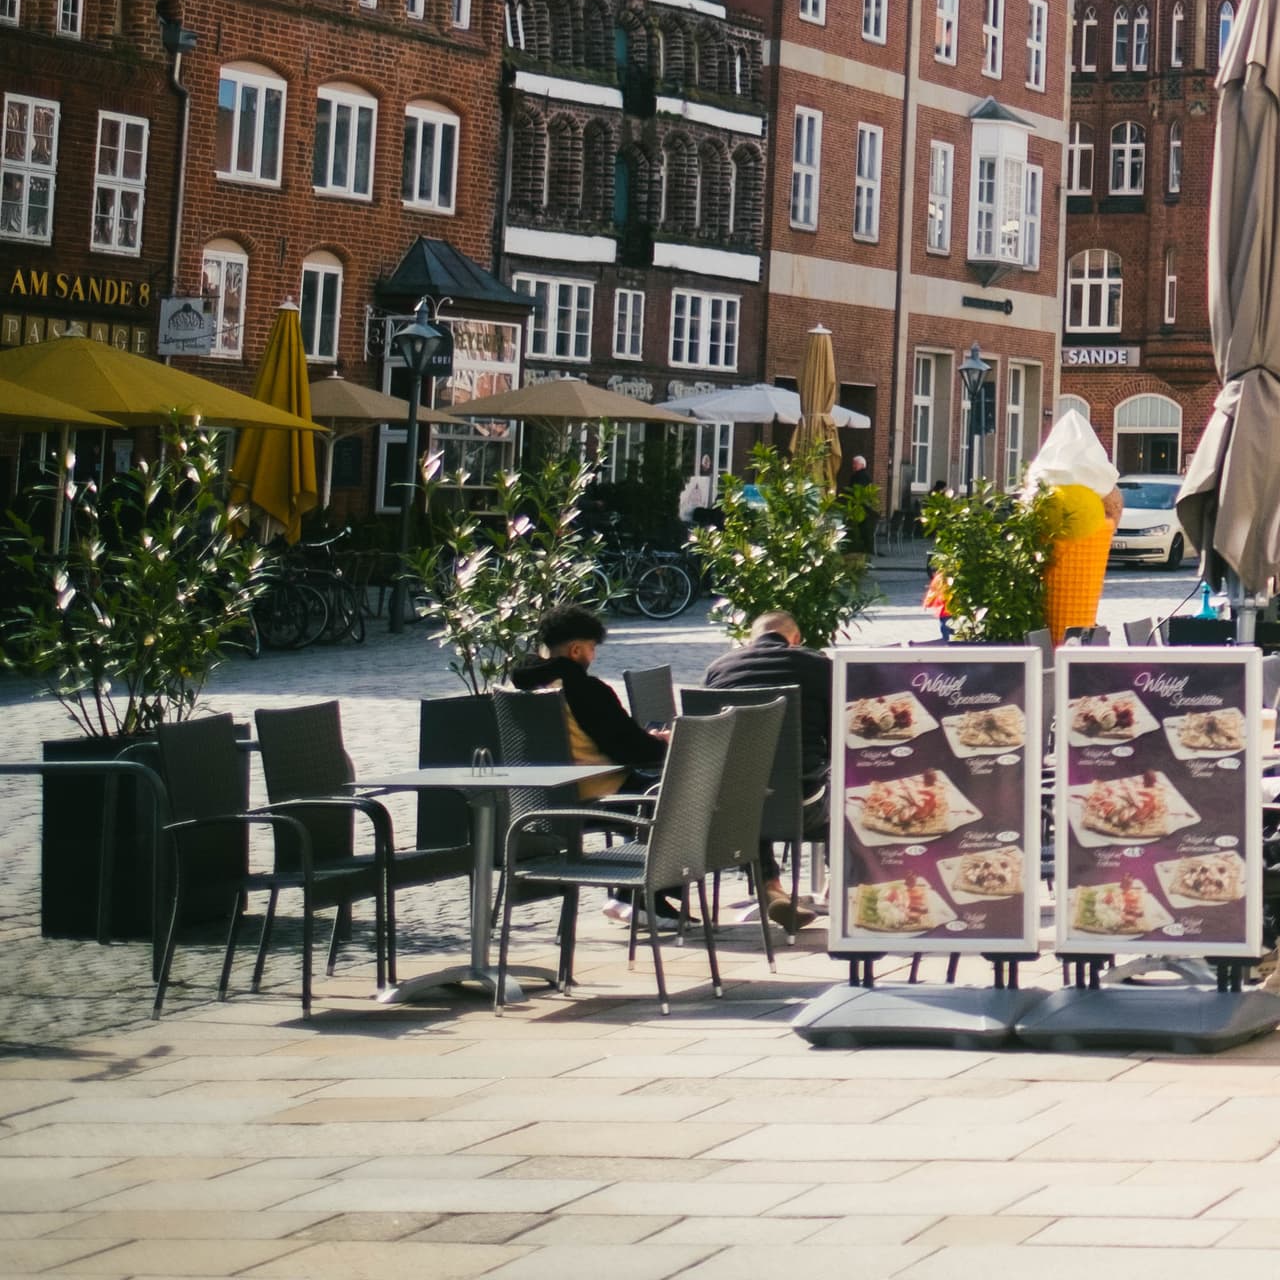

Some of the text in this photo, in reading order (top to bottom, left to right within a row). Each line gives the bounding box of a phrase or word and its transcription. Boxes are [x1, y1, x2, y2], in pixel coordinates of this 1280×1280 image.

[10, 269, 151, 308] AM SANDE 8
[1068, 349, 1128, 365] SANDE
[911, 672, 968, 697] Waffel
[1134, 672, 1190, 697] Waffel
